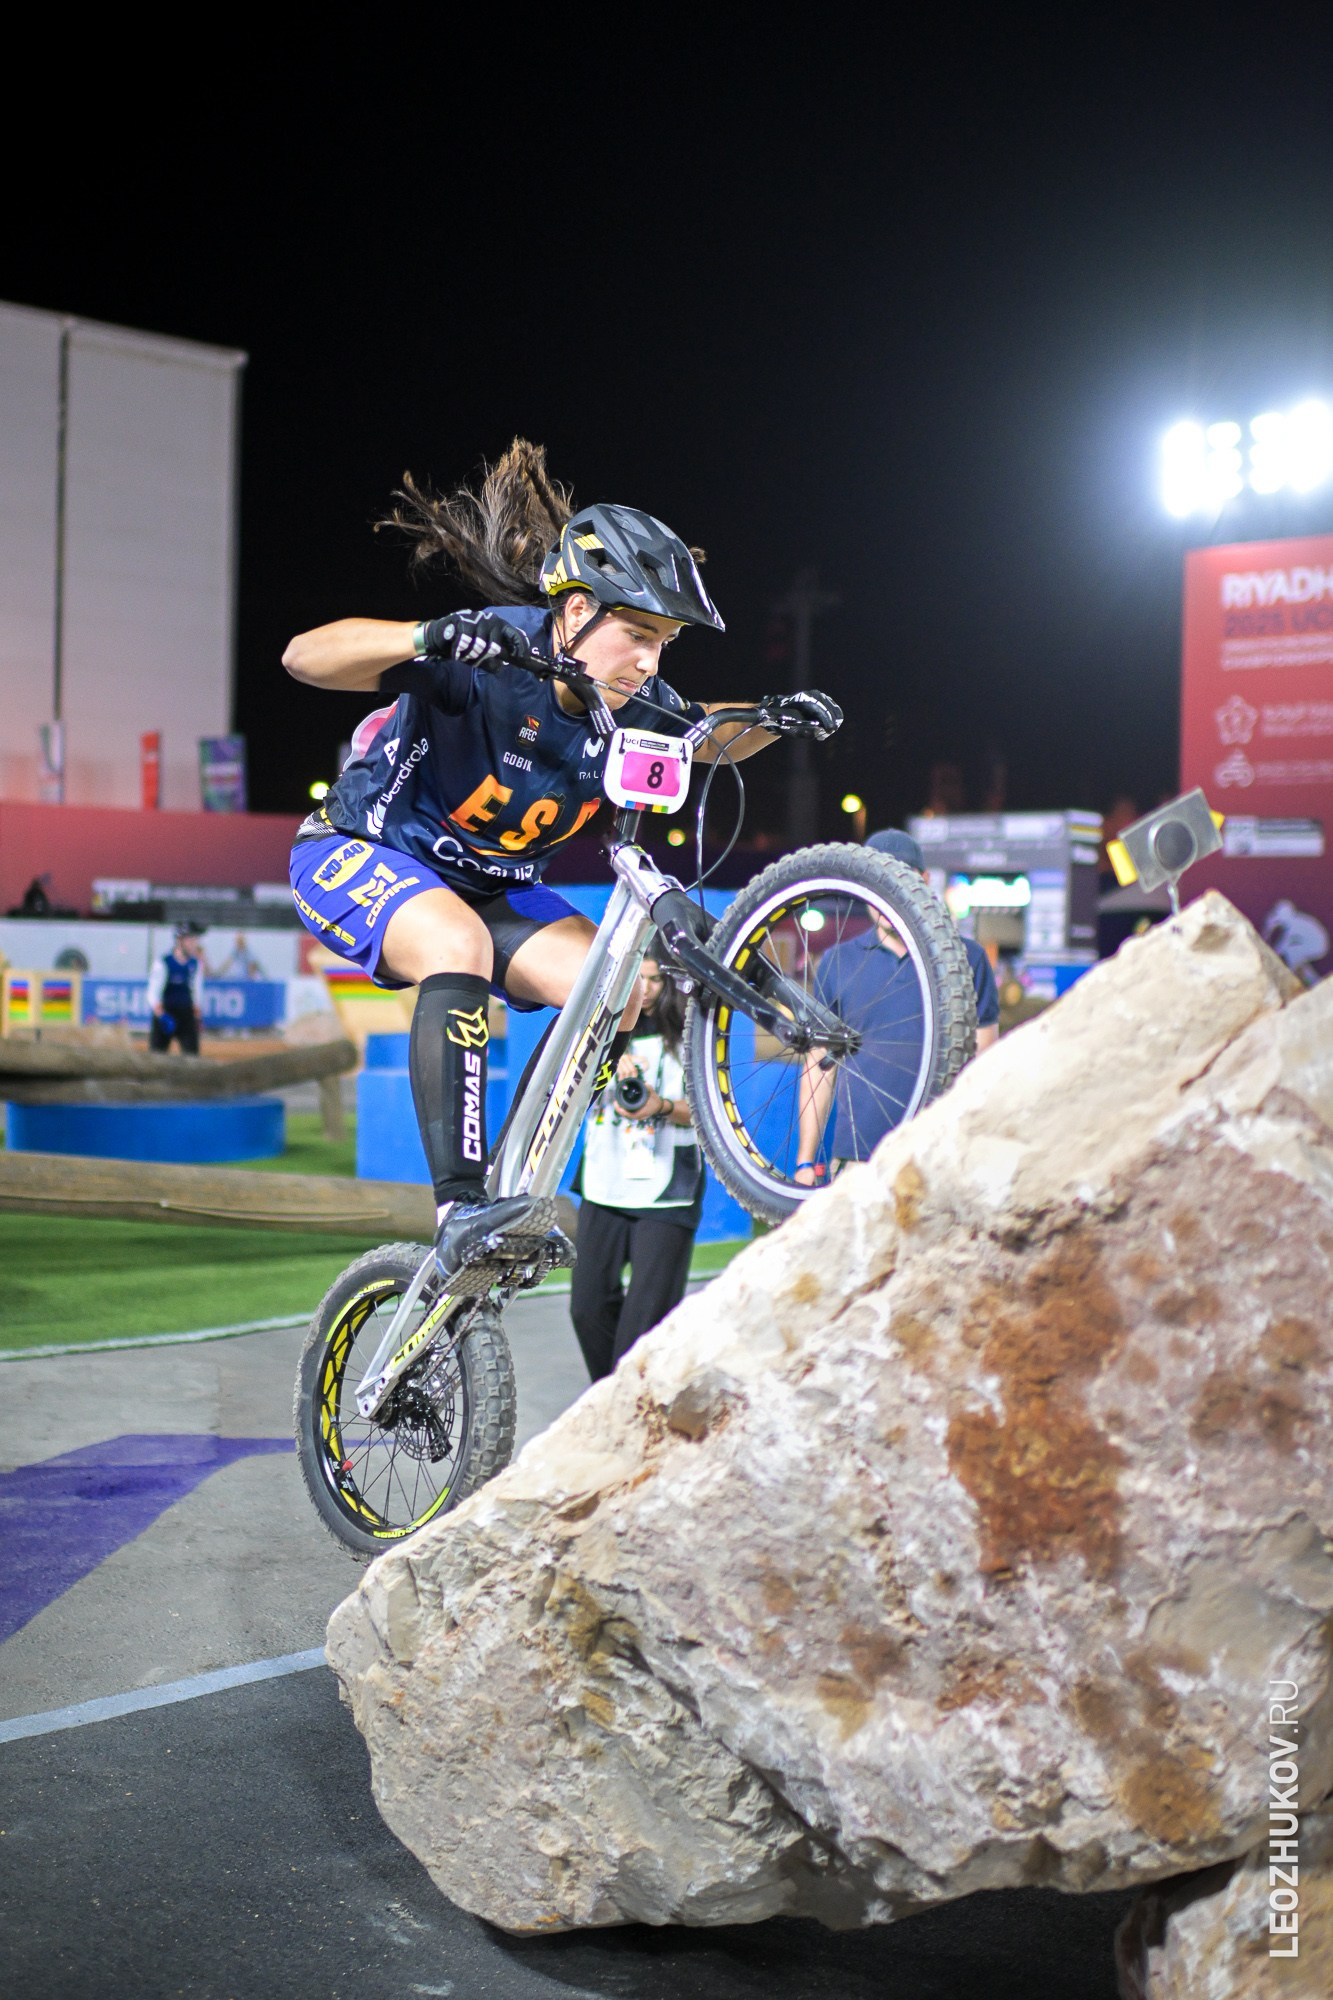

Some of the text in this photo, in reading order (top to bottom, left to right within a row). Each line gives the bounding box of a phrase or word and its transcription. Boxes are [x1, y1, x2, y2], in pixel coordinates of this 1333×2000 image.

[519, 727, 537, 742] RFEC
[503, 751, 532, 772] GOBIK
[647, 761, 664, 789] 8
[319, 842, 366, 883] WD-40
[292, 889, 357, 946] COMAS
[464, 1051, 482, 1162] COMAS
